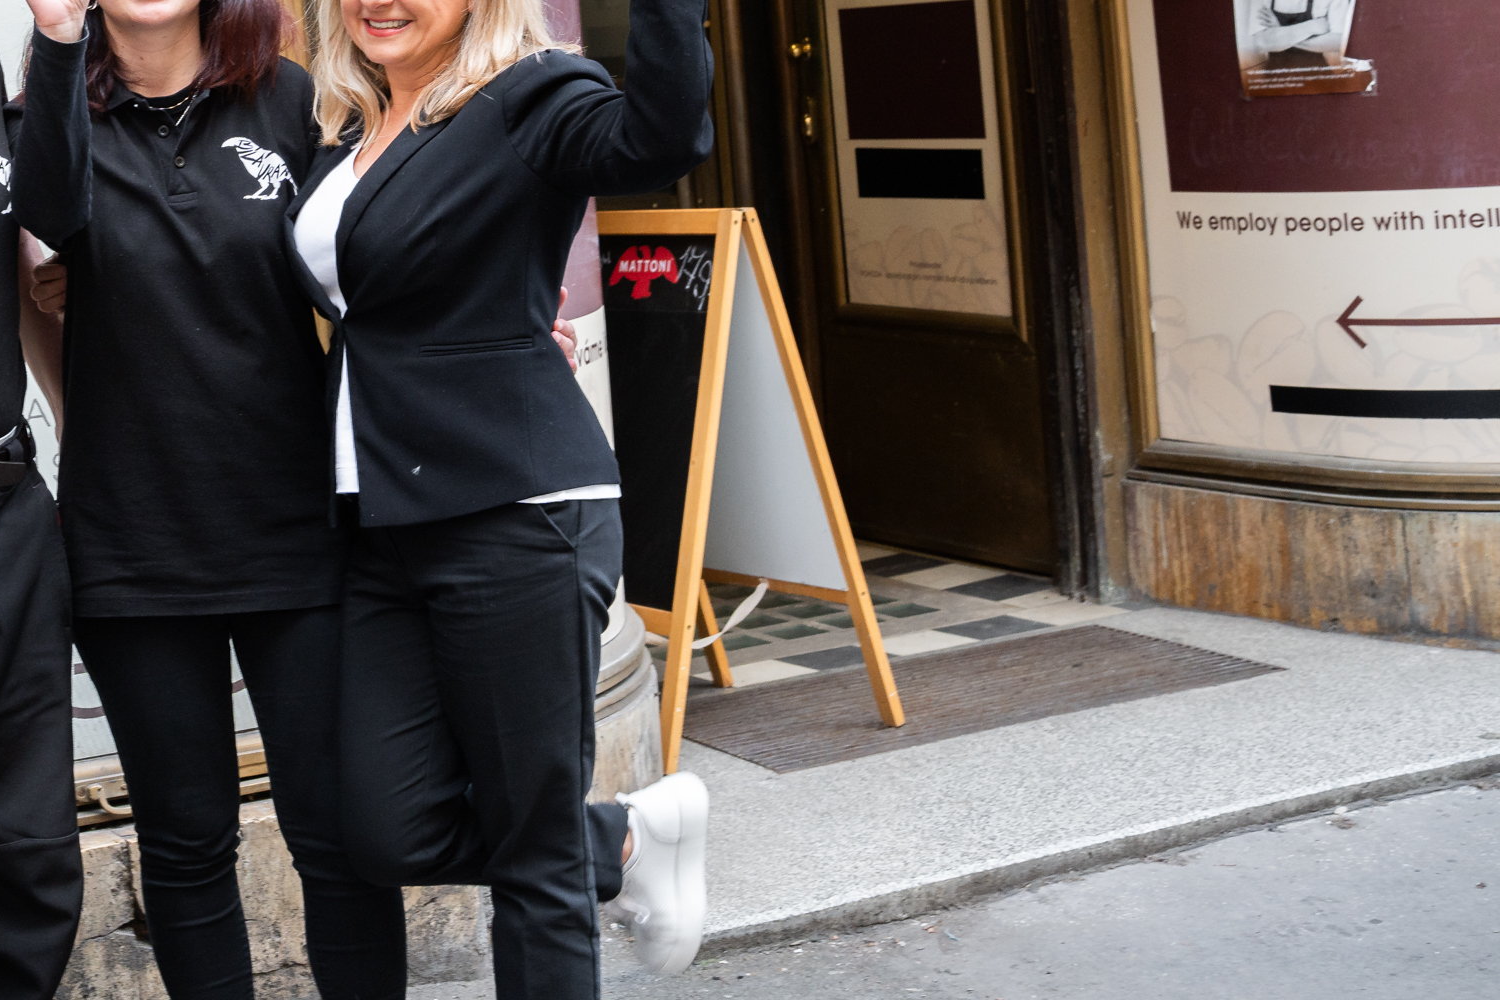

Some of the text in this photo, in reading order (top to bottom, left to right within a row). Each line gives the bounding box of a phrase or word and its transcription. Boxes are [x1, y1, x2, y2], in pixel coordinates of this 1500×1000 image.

[1176, 210, 1203, 230] We
[1209, 212, 1278, 235] employ
[1285, 213, 1365, 236] people
[1373, 210, 1424, 232] with
[618, 259, 673, 273] MATTONI
